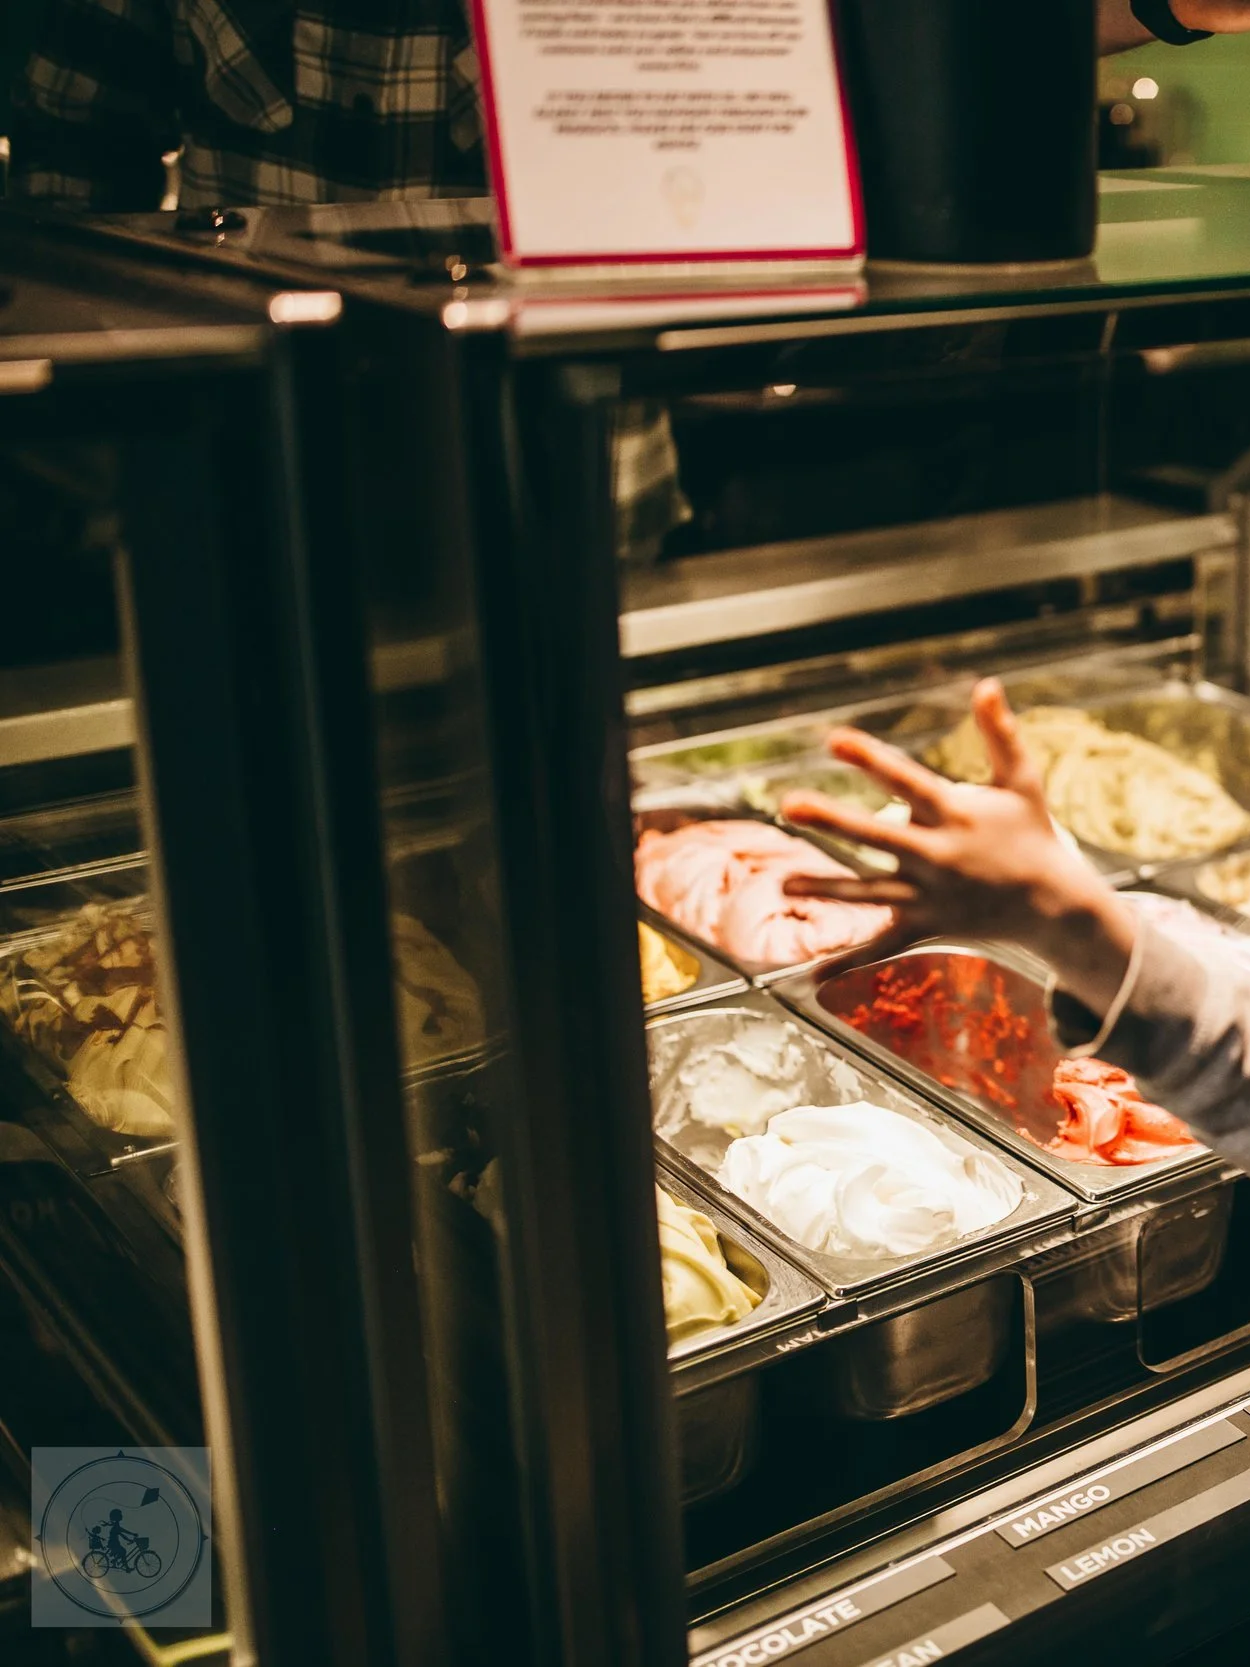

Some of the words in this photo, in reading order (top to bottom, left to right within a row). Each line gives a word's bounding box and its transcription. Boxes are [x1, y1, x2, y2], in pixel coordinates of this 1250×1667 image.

[1012, 1485, 1110, 1538] MANGO
[1060, 1528, 1156, 1581] LEMON
[707, 1598, 862, 1667] OCOLATE
